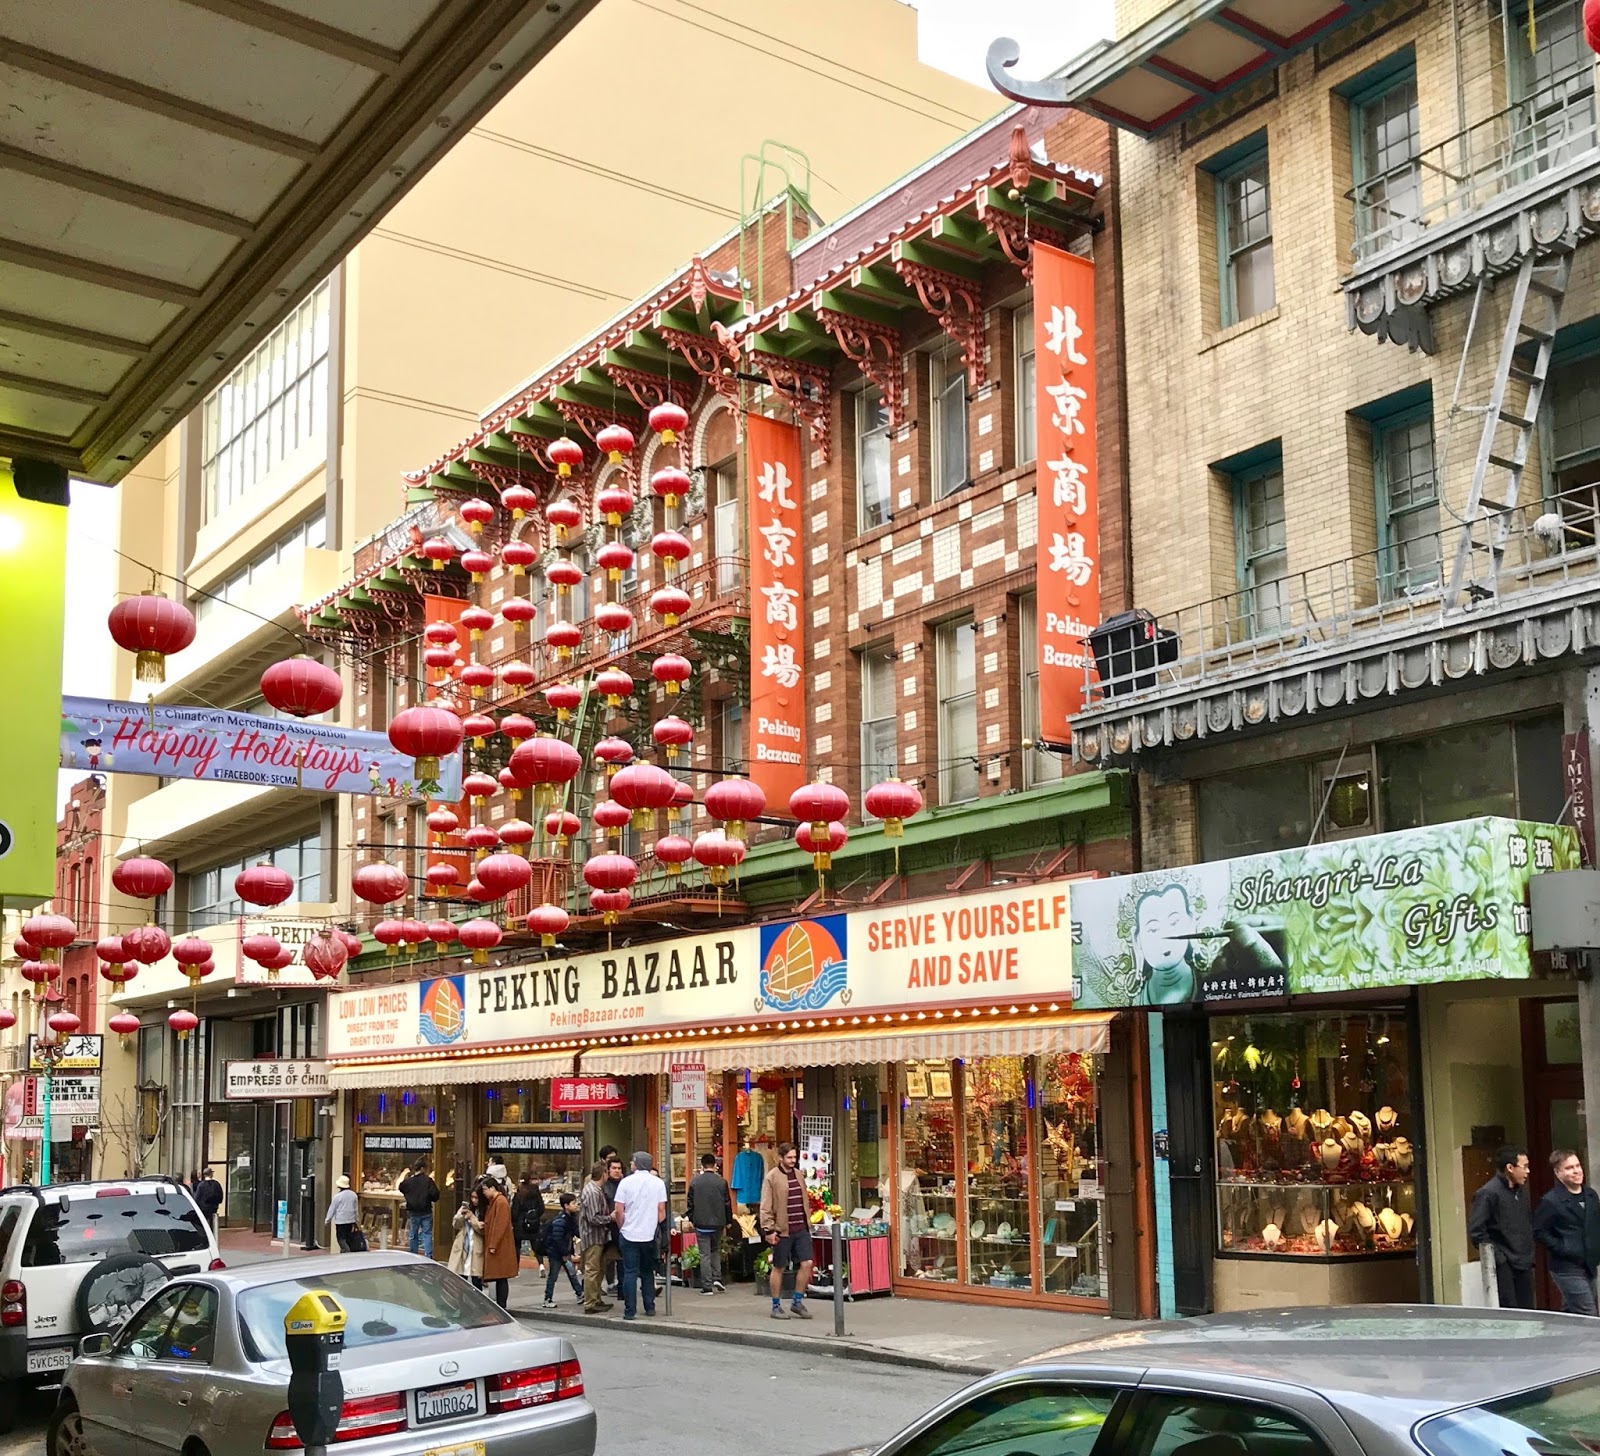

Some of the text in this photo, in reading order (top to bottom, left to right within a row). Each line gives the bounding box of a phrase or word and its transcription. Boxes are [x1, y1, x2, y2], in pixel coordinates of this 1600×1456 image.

[1043, 305, 1094, 586] 北京商場
[757, 461, 803, 688] 北京商場
[1043, 644, 1098, 671] Bazar
[107, 703, 139, 716] From
[165, 709, 224, 724] Chinatown
[227, 716, 285, 732] Merchants
[287, 724, 347, 740] Association
[758, 717, 801, 742] Peking
[112, 716, 364, 790] Happy Holidays
[756, 744, 802, 765] Bazaar
[224, 769, 298, 785] FACEBOOK: SFCMA
[1234, 855, 1424, 910] Shangri-La
[868, 895, 1066, 952] SERVE YOURSELF
[1402, 893, 1500, 949] Gifts
[478, 941, 738, 1013] PEKING BAZAAR
[907, 948, 1018, 989] AND SAVE
[1314, 974, 1344, 987] Grant
[1373, 969, 1393, 981] San
[1397, 965, 1452, 979] Francisco
[340, 992, 407, 1019] LOW LOW PRICES
[550, 1005, 645, 1028] PekingBazaar.com
[347, 1019, 398, 1033] DIRECT FROM THE
[350, 1034, 395, 1047] ORIENT TO YOU
[230, 1075, 281, 1086] EMPRESS
[285, 1075, 298, 1085] OF
[672, 1071, 704, 1082] NO STOPPING
[682, 1083, 695, 1091] ANY
[559, 1083, 620, 1101] 清倉特價
[681, 1092, 696, 1101] TIME
[71, 1115, 97, 1124] CENTER
[488, 1136, 510, 1149] ELEGANT
[510, 1136, 532, 1149] JEWELRY
[532, 1136, 540, 1149] TO
[540, 1136, 548, 1149] FIT
[548, 1136, 563, 1149] YOUR
[34, 1315, 58, 1324] Jeep
[30, 1355, 71, 1370] 5VKC583
[420, 1394, 473, 1418] 7JUR062
